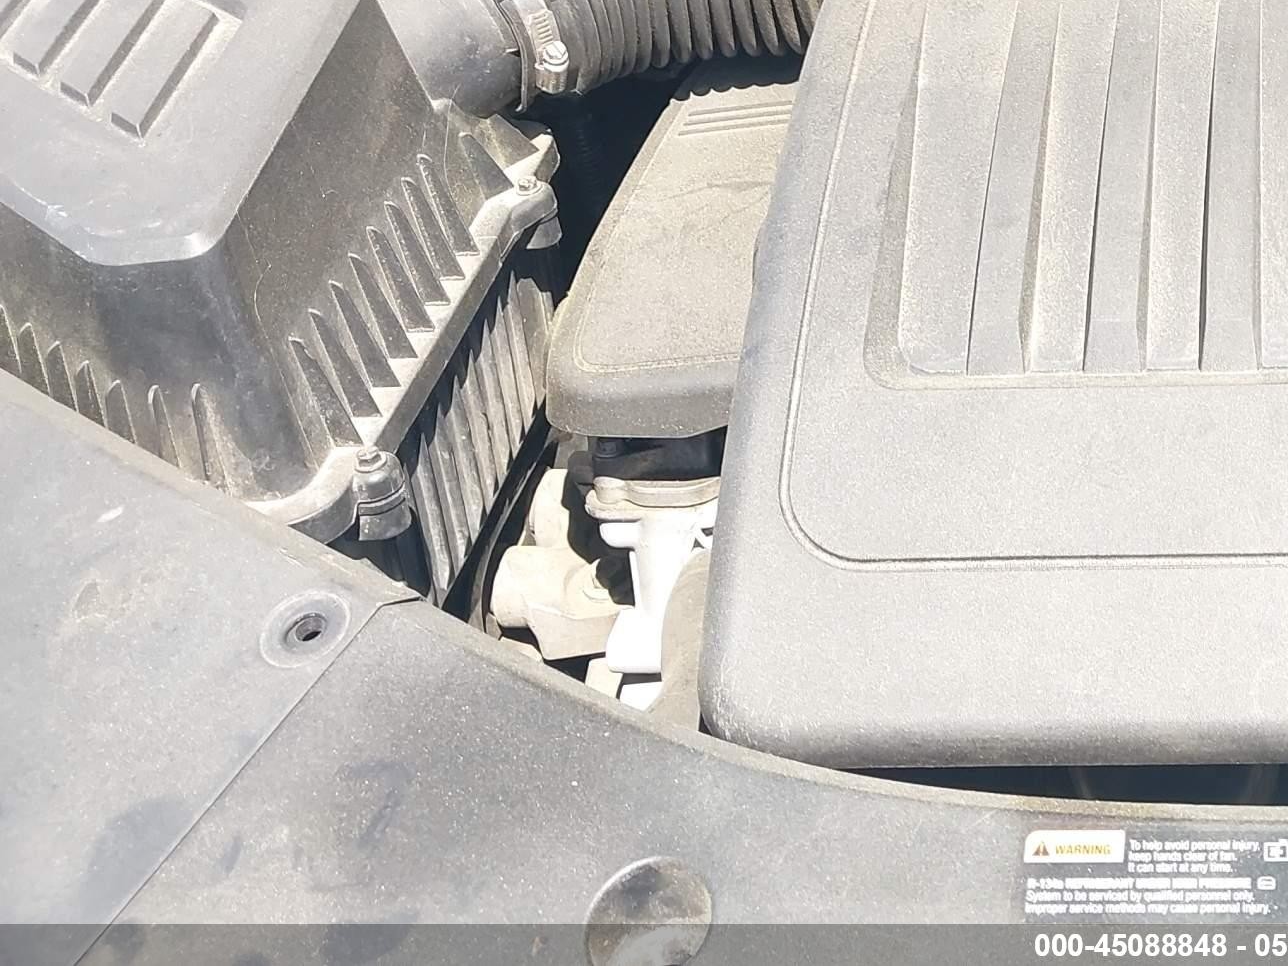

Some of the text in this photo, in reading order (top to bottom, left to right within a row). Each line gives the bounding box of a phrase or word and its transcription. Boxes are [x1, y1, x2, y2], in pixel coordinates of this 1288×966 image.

[1055, 844, 1112, 855] WARNING
[1129, 839, 1141, 850] To
[1142, 840, 1162, 851] help
[1164, 840, 1190, 850] avoid
[1191, 840, 1231, 851] personal
[1128, 851, 1238, 862] keep hands clear of fan.
[1128, 862, 1233, 874] It can start at any time.
[1026, 890, 1255, 902] System to be serviced by qualified personnel only.
[1025, 903, 1271, 915] Improper service methods may cause personal injury.
